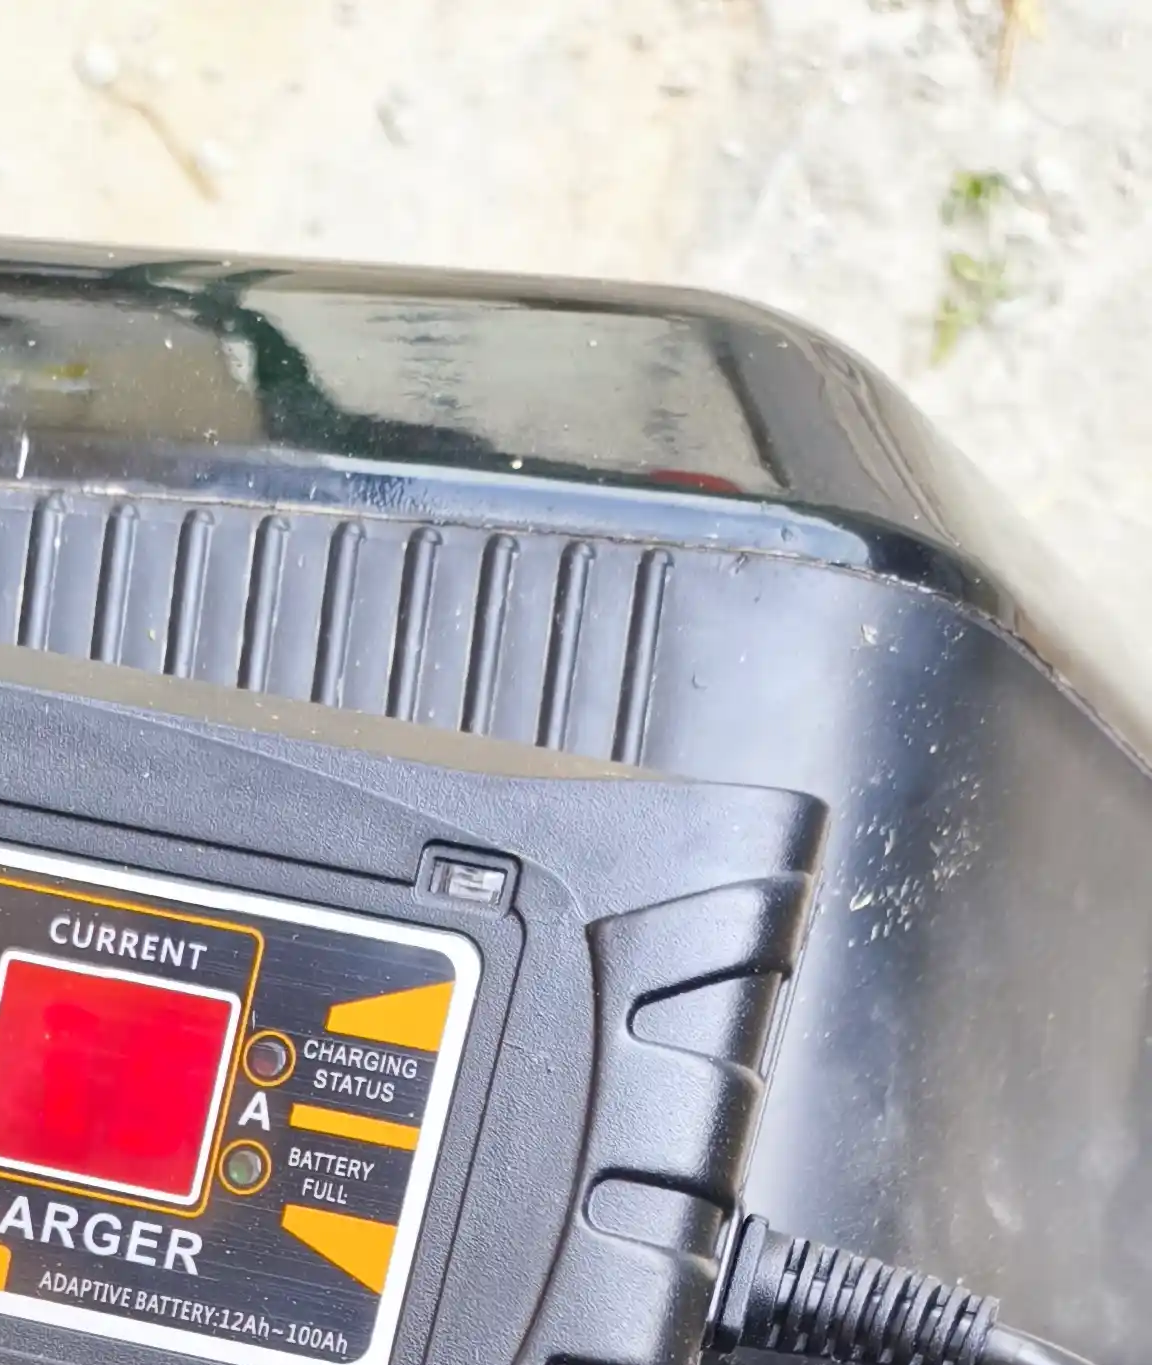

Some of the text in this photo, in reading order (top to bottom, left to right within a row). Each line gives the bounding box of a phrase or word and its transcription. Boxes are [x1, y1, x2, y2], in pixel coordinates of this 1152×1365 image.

[49, 916, 208, 970] CURRENT
[303, 1040, 418, 1079] CHARGING
[313, 1070, 396, 1103] STATUS
[238, 1092, 271, 1132] A
[288, 1146, 375, 1182] BATTERY
[301, 1177, 347, 1205] FULL
[38, 1270, 134, 1308] ADAPTIVE
